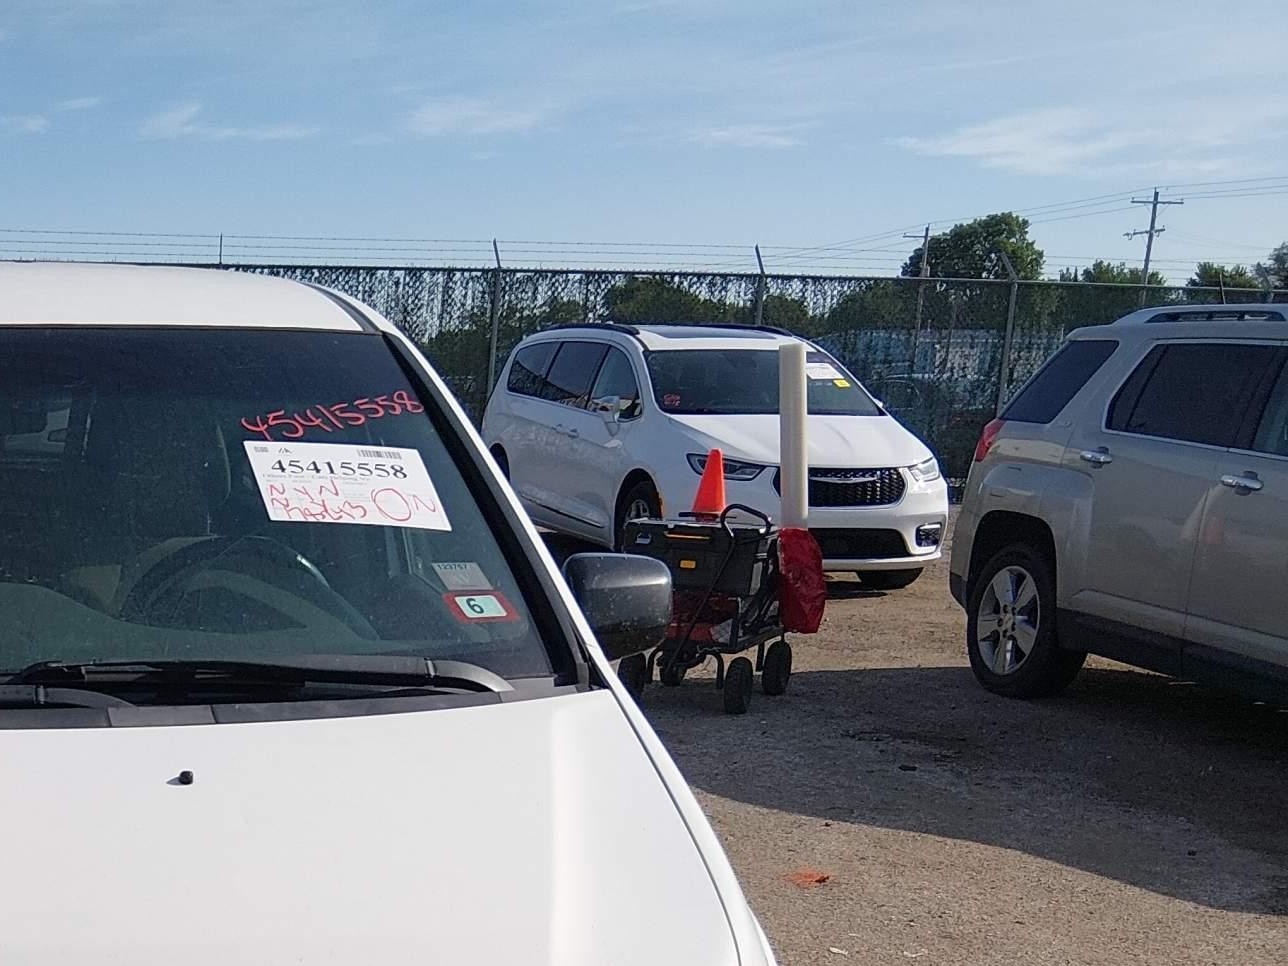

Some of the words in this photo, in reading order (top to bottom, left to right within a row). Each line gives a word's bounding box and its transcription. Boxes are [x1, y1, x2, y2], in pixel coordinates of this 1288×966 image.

[241, 390, 424, 441] 45415558
[271, 459, 408, 480] 45415558
[465, 598, 484, 614] 6
